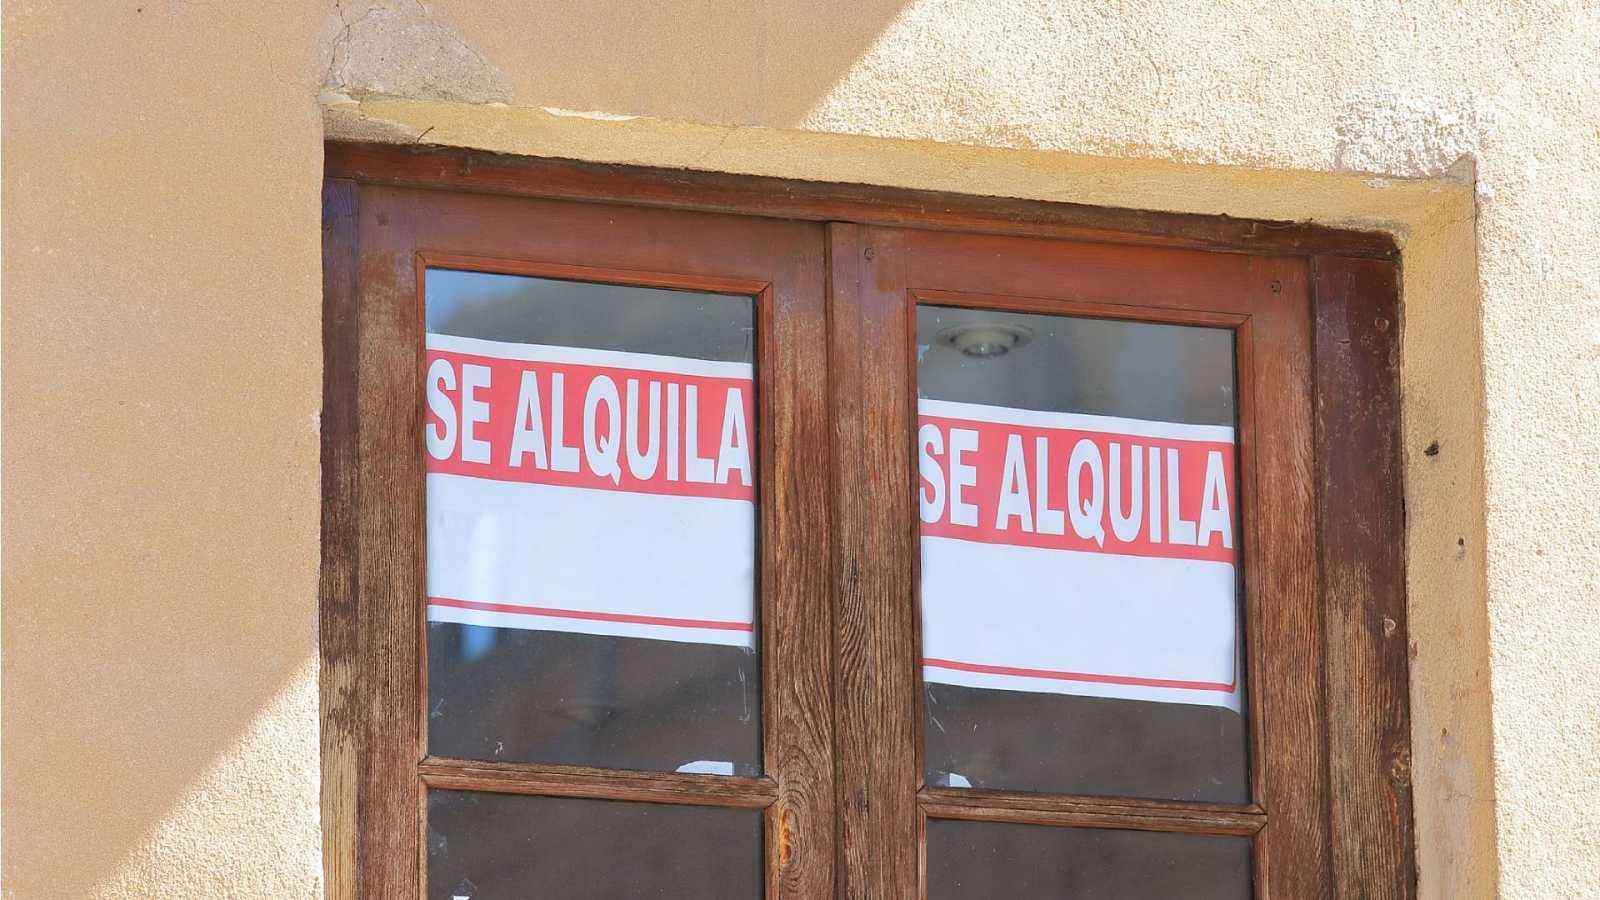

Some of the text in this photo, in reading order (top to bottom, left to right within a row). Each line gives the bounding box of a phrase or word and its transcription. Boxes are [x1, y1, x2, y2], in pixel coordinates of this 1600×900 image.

[426, 358, 752, 486] SE ALQUILA
[918, 423, 1233, 549] SE ALQUILA
